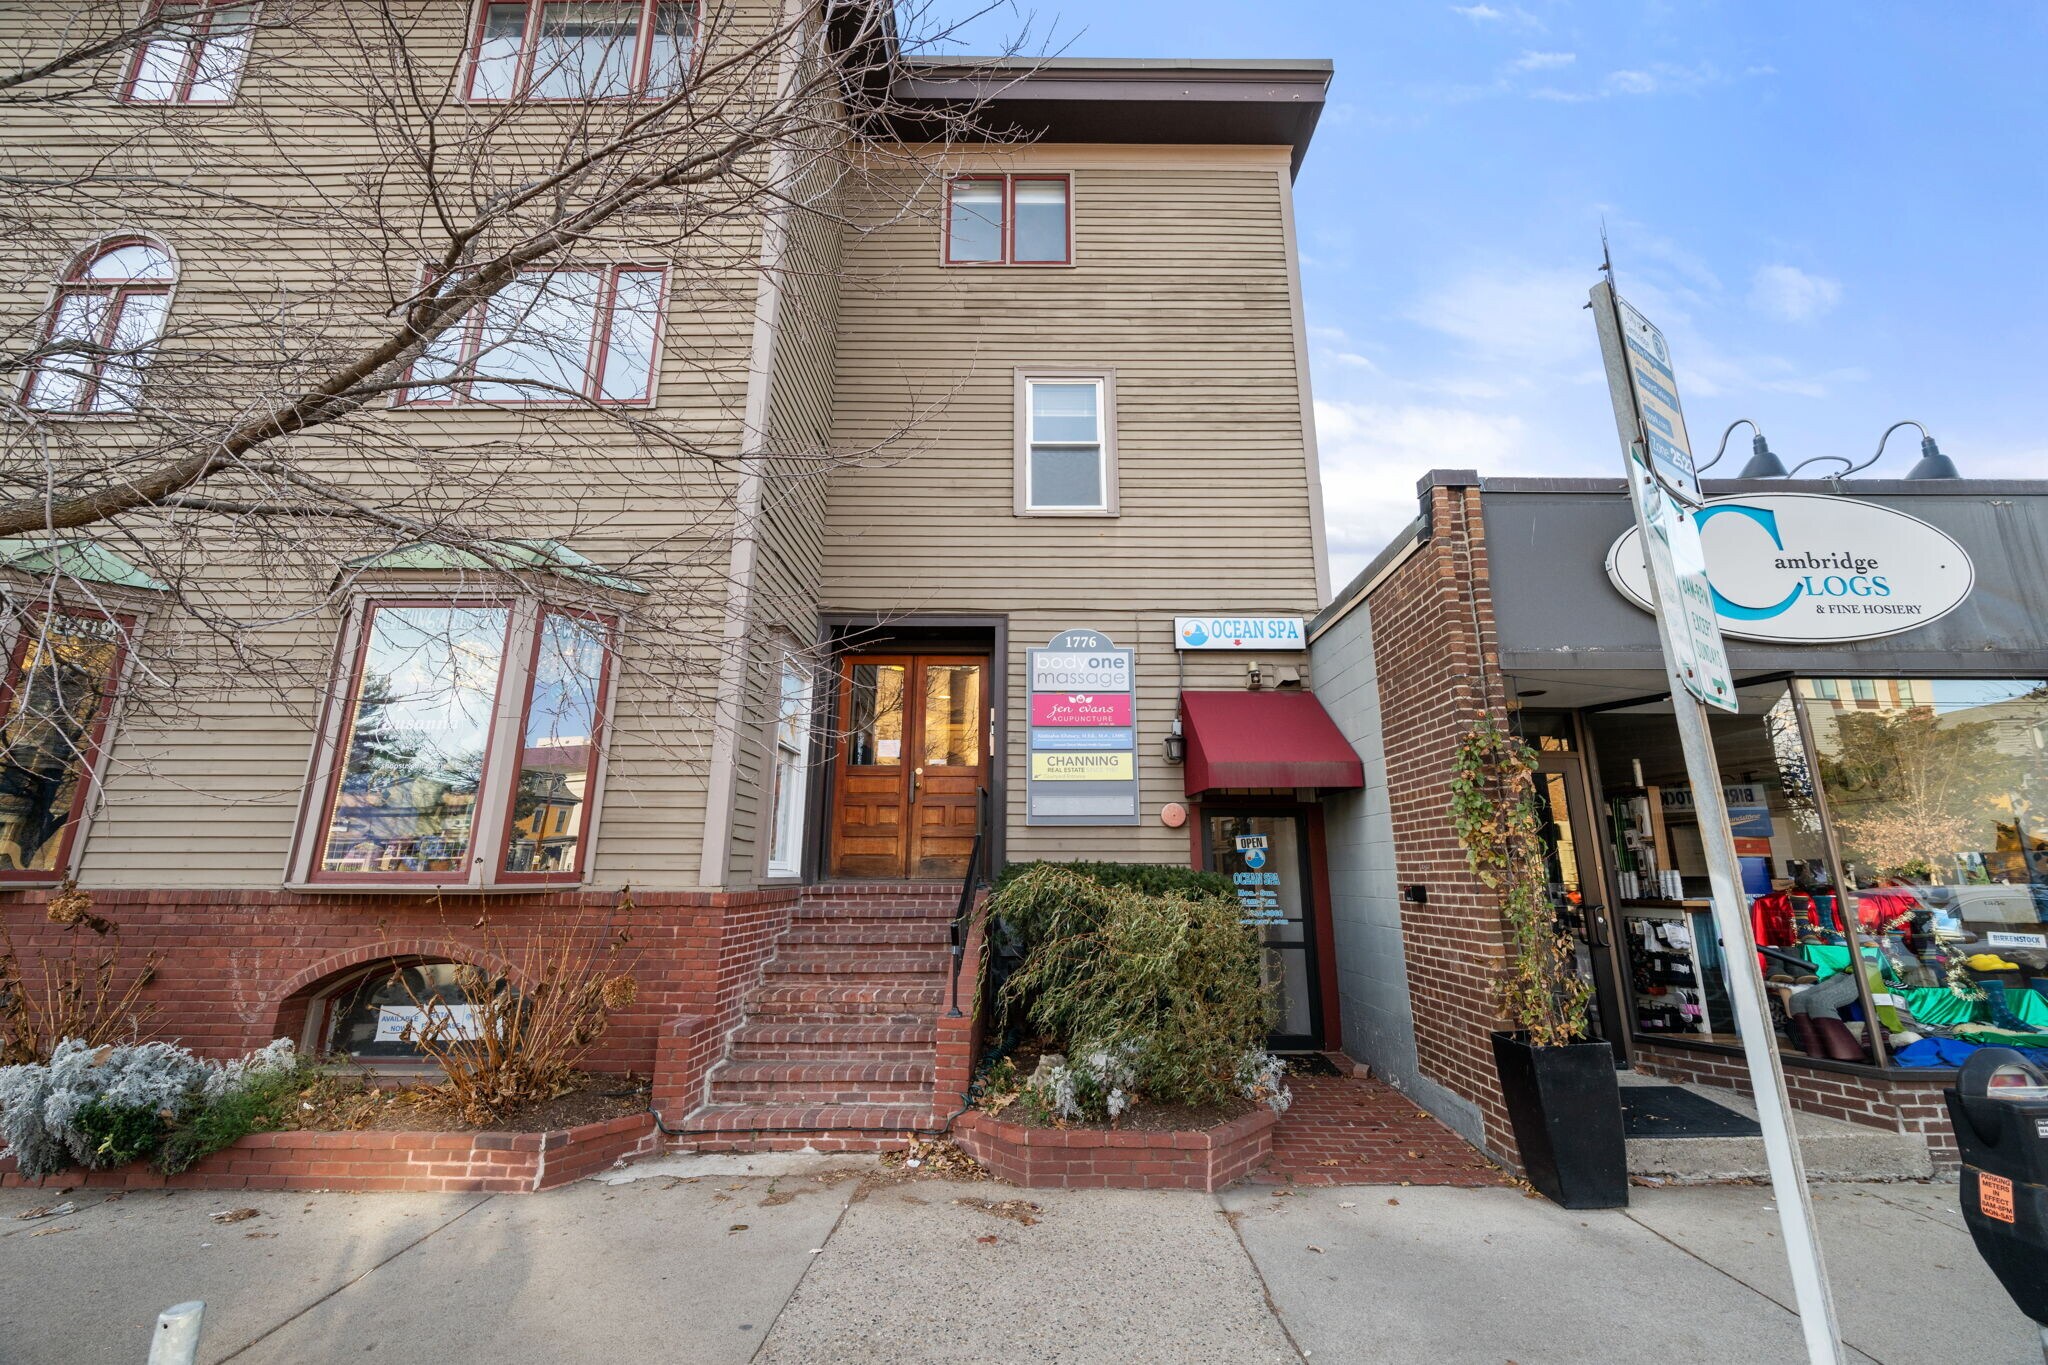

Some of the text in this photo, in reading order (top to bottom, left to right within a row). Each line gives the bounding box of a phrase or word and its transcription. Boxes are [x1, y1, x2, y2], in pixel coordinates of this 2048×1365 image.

[1816, 604, 1922, 615] & FINE HOSIERY
[1211, 619, 1299, 639] OCEAN SPA
[1065, 636, 1097, 648] 1776
[1037, 672, 1126, 688] massage
[1078, 704, 1114, 713] evans
[1047, 755, 1119, 767] CHANNING
[1240, 837, 1263, 848] OPEN
[1232, 872, 1281, 886] OCEAN SPA
[1992, 934, 2041, 944] BIRKENSTOCK
[1981, 1173, 2010, 1186] PARKING
[1982, 1180, 2010, 1192] METERS
[1984, 1194, 2009, 1206] EFFECT
[1982, 1207, 2013, 1222] MON-SAT
